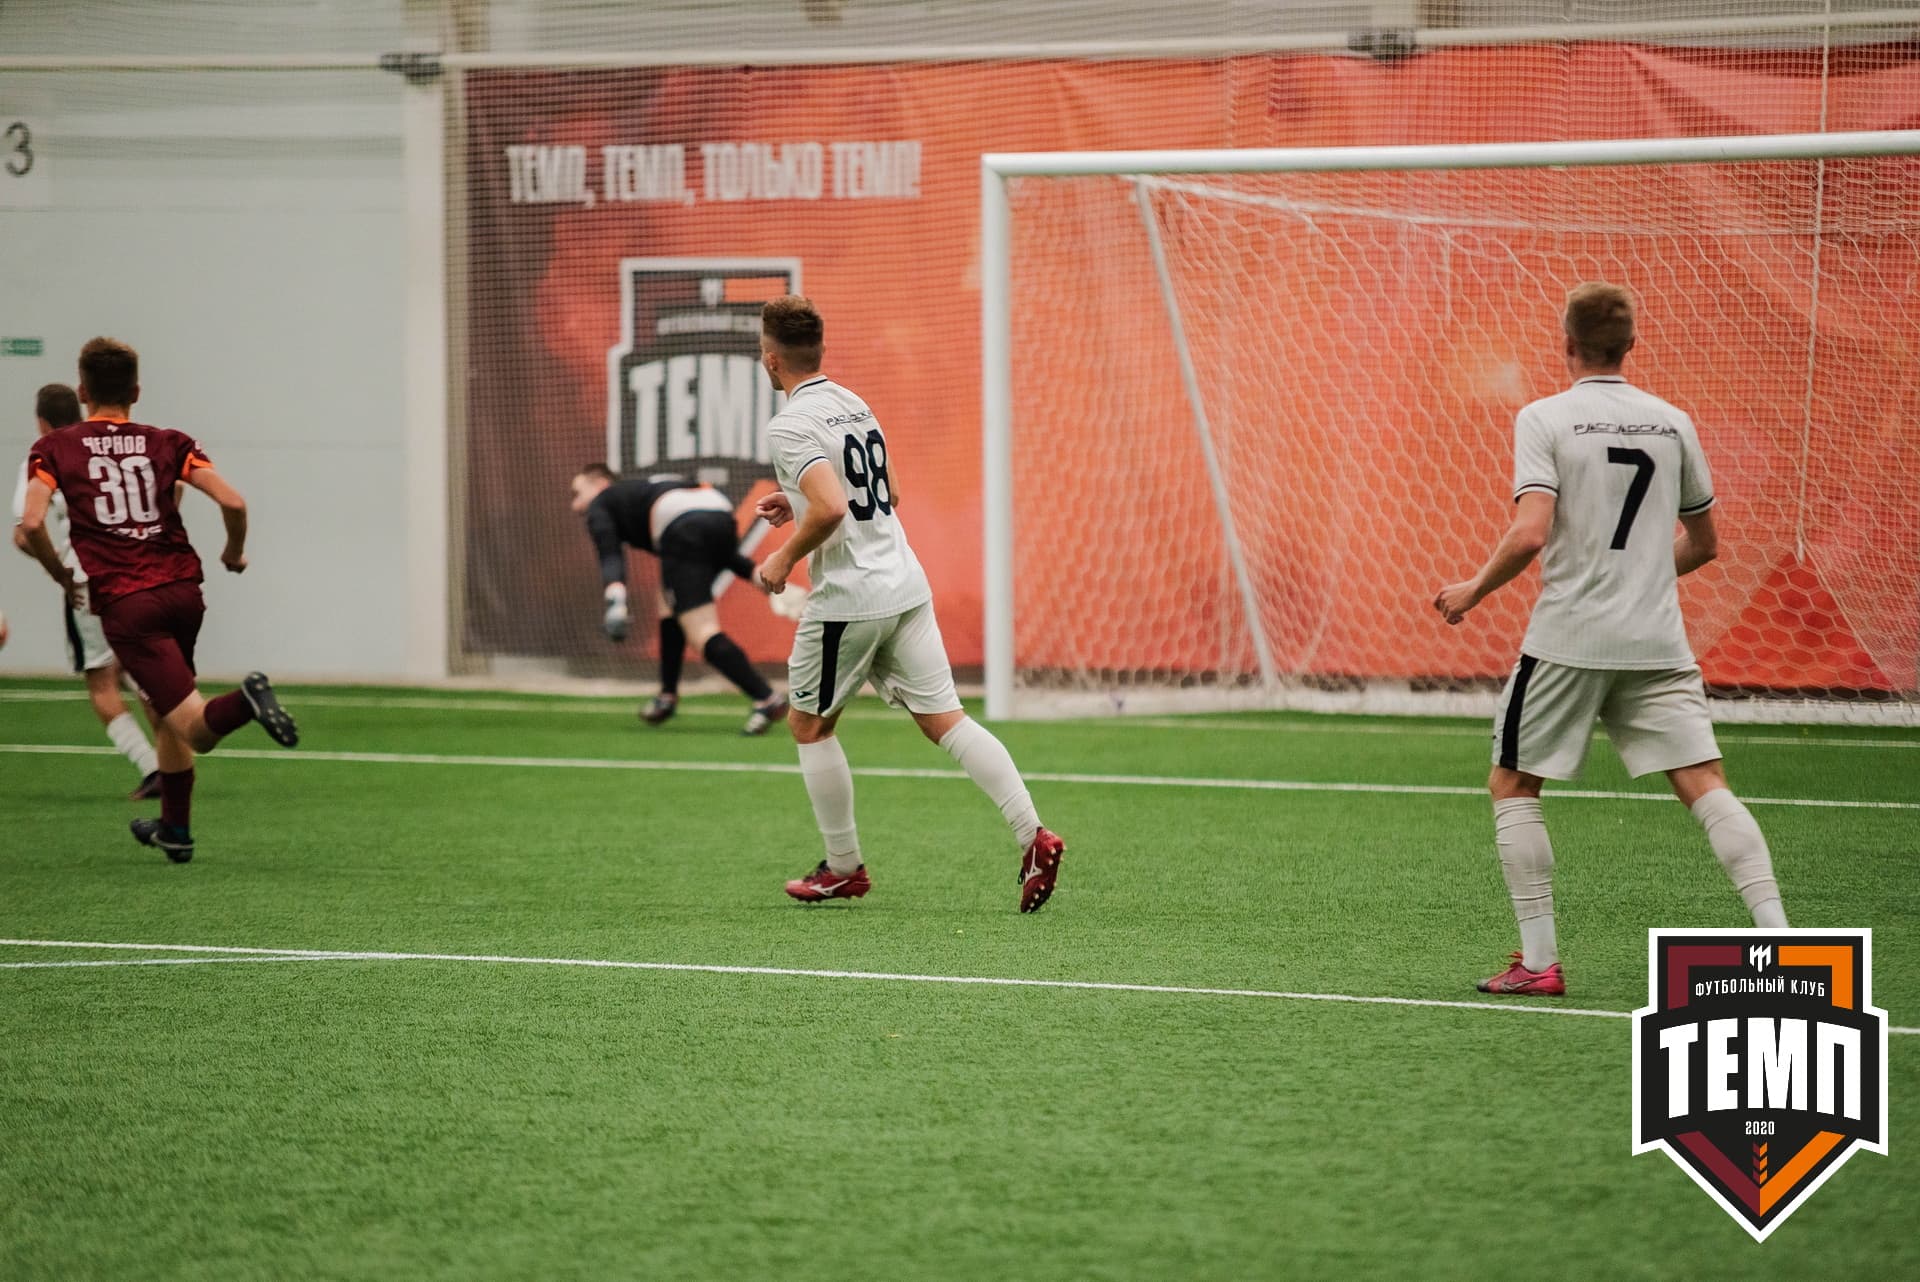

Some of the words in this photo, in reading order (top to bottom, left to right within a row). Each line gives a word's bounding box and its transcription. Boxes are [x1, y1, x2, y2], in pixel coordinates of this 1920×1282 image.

[4, 121, 33, 177] 3
[701, 142, 823, 199] ТОЛЬКО
[82, 435, 146, 455] ЧЕРНОВ
[844, 428, 891, 521] 98
[88, 455, 160, 525] 30
[1607, 446, 1656, 550] 7
